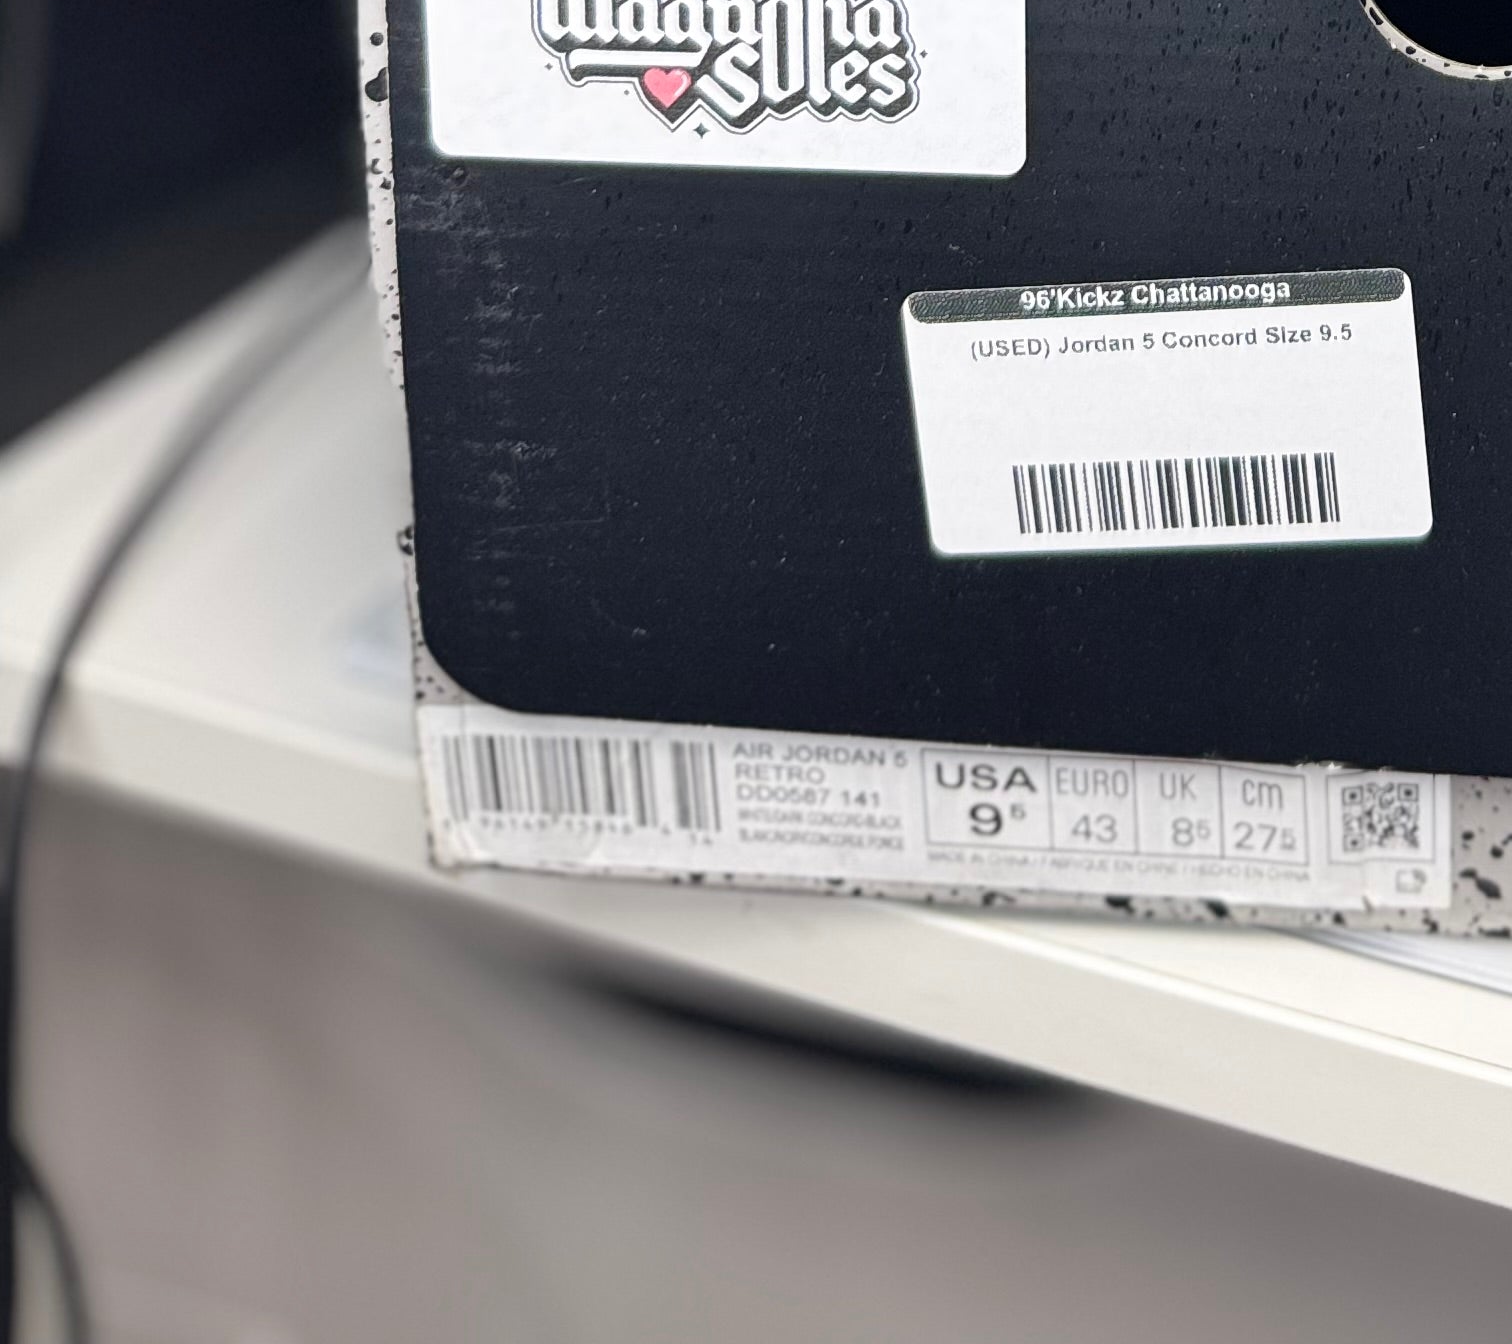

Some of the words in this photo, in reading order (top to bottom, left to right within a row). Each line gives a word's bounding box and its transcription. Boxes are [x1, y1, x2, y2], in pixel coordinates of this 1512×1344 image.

[1019, 289, 1125, 312] 96'Kickz
[1131, 280, 1291, 306] Chattanooga
[970, 338, 1051, 361] (USED)
[1058, 334, 1135, 354] Jordan
[1143, 333, 1155, 349] 5
[1162, 327, 1258, 349] Concord
[1266, 325, 1312, 344] Size
[1320, 323, 1353, 341] 9.5
[733, 742, 774, 760] AIR
[781, 744, 886, 765] JORDAN
[735, 763, 825, 785] RETRO
[935, 761, 1037, 794] USA
[1055, 767, 1129, 798] EURO
[1160, 772, 1197, 800] UK
[840, 789, 881, 808] 141
[1071, 814, 1118, 844] 43
